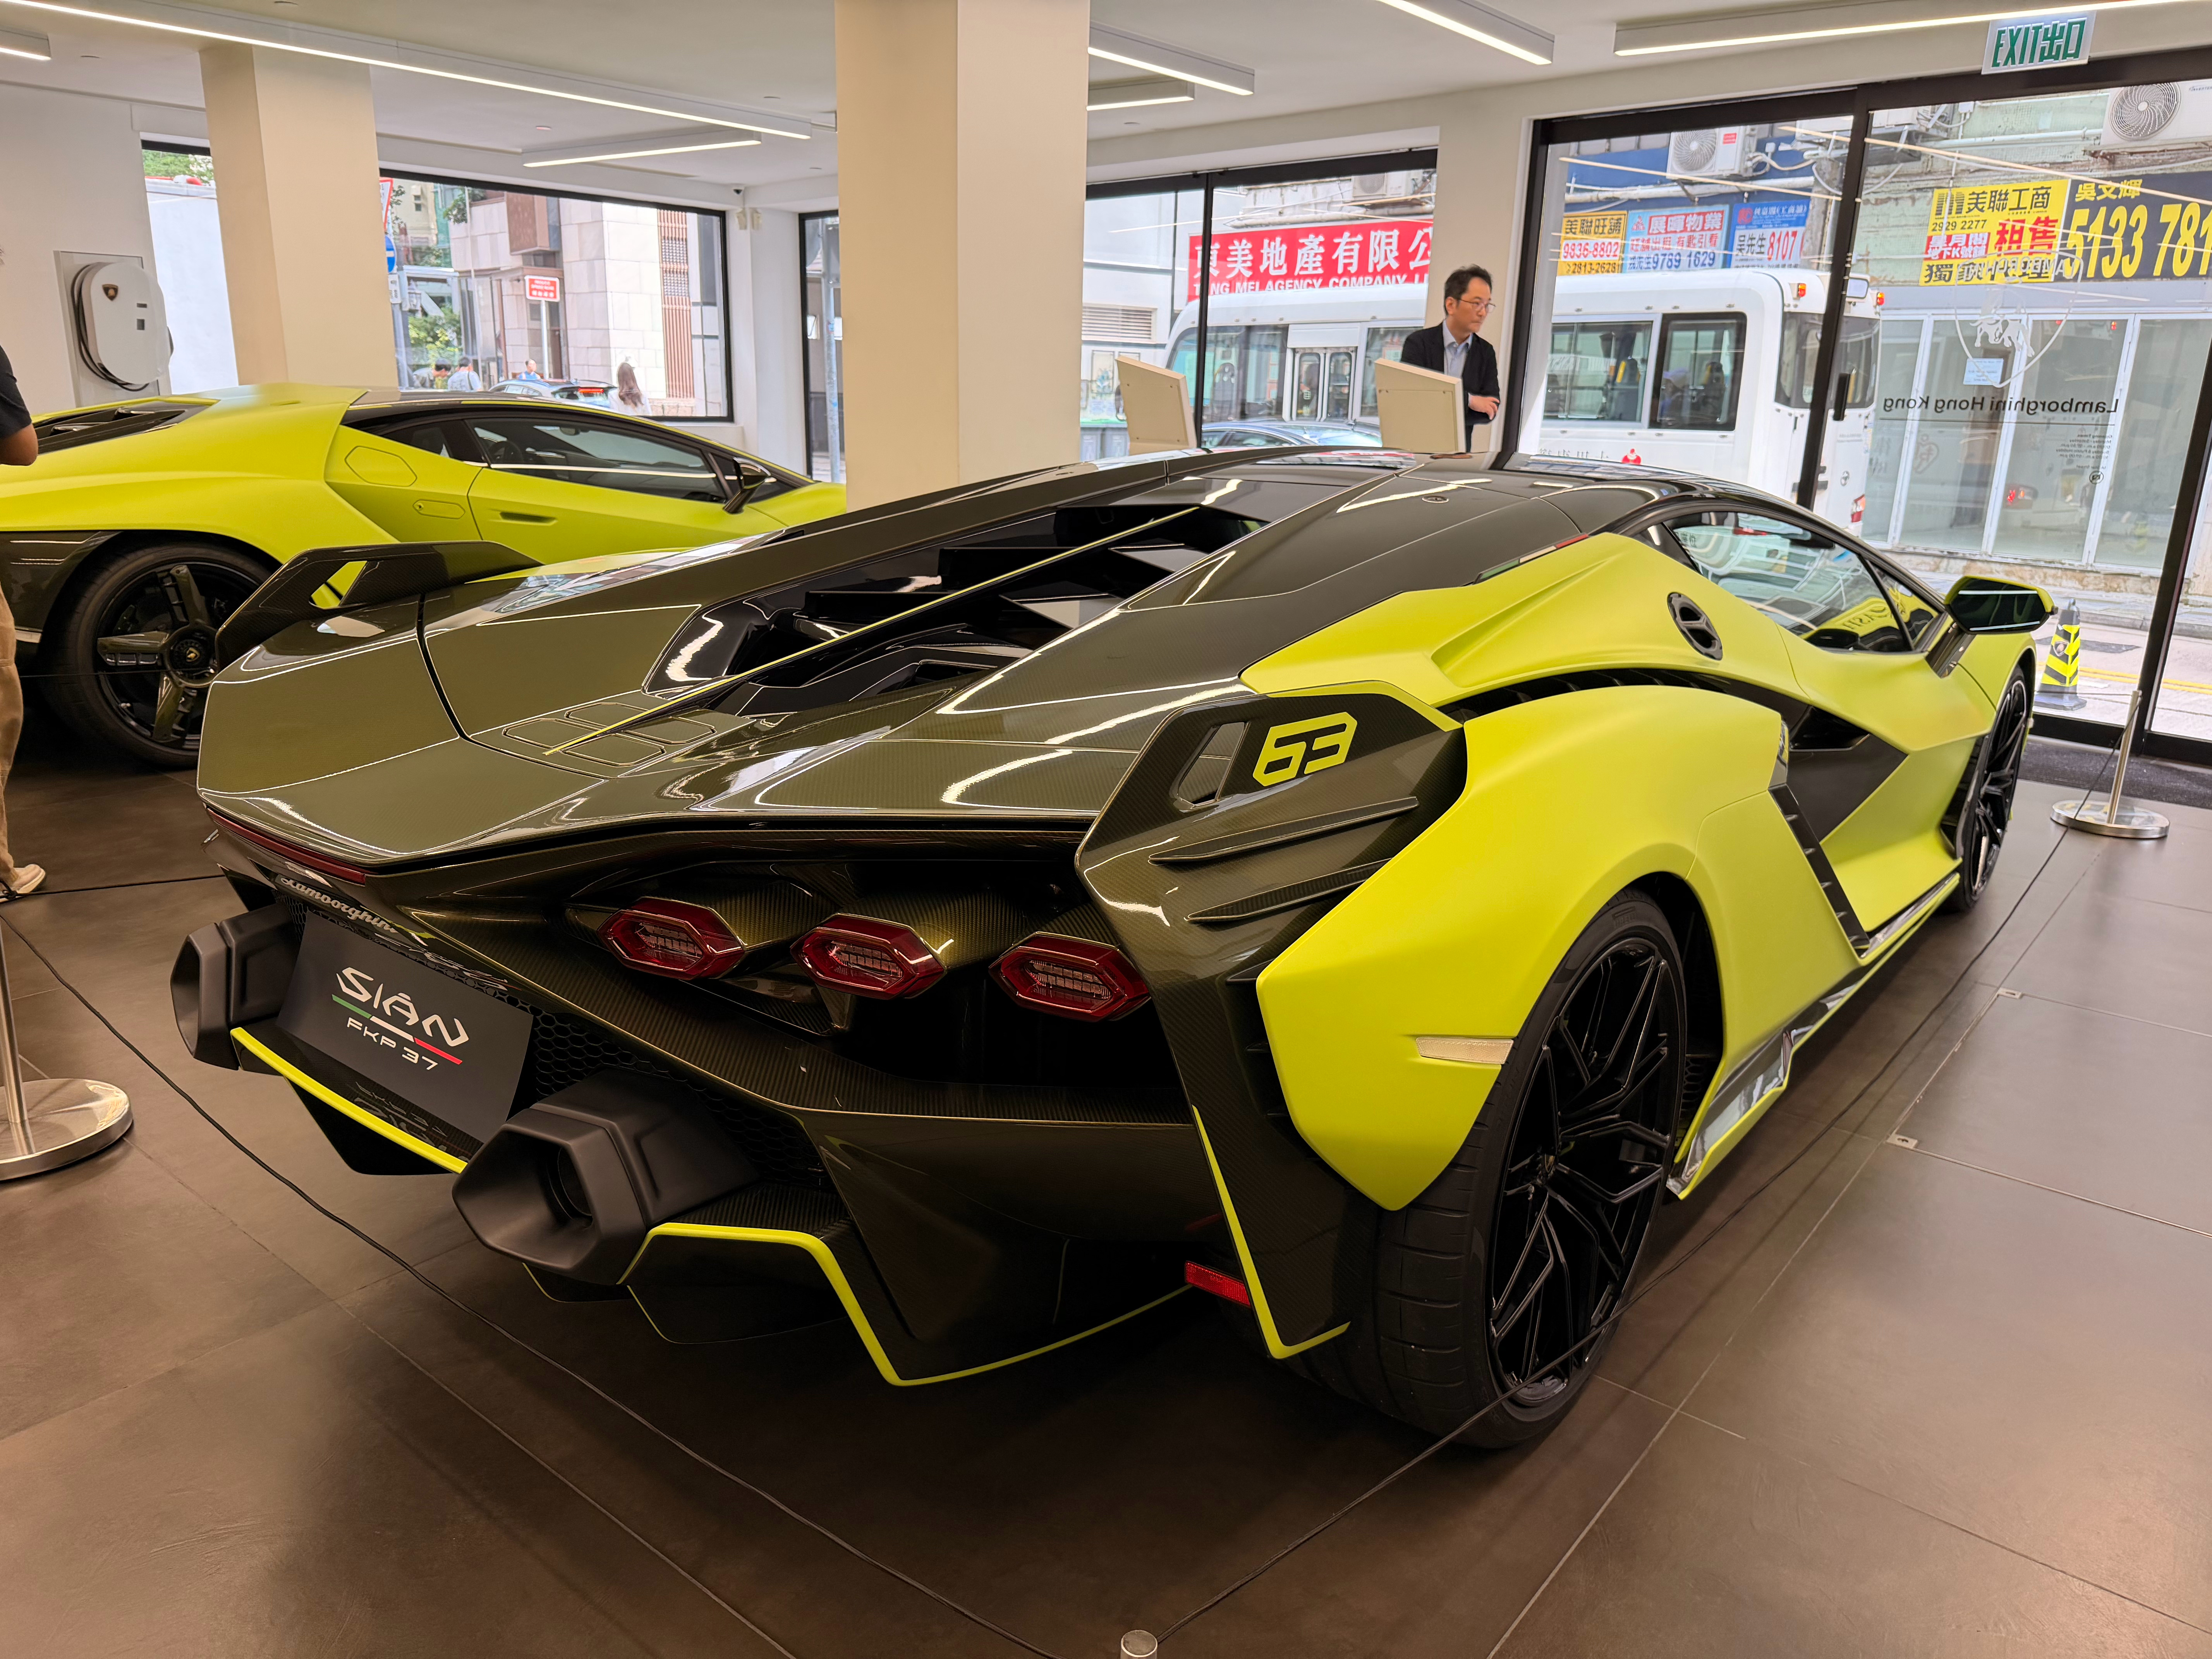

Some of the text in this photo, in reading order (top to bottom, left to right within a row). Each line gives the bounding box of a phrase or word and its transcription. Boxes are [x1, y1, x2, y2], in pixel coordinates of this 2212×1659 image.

[1992, 18, 2086, 68] EXIT 出口
[1966, 186, 2051, 214] 美聯工商
[1932, 219, 1987, 232] 2929 2277
[1994, 216, 2058, 256] 租售
[2063, 204, 2148, 279] 5133
[1652, 252, 1681, 270] 9789
[1687, 251, 1716, 268] 1629
[1767, 230, 1798, 261] 8107
[1194, 282, 1230, 296] TNG
[1265, 278, 1323, 291] AGENCY
[1329, 273, 1408, 288] COMPANY
[1252, 711, 1357, 787] 63
[347, 1017, 438, 1070] FKP 37
